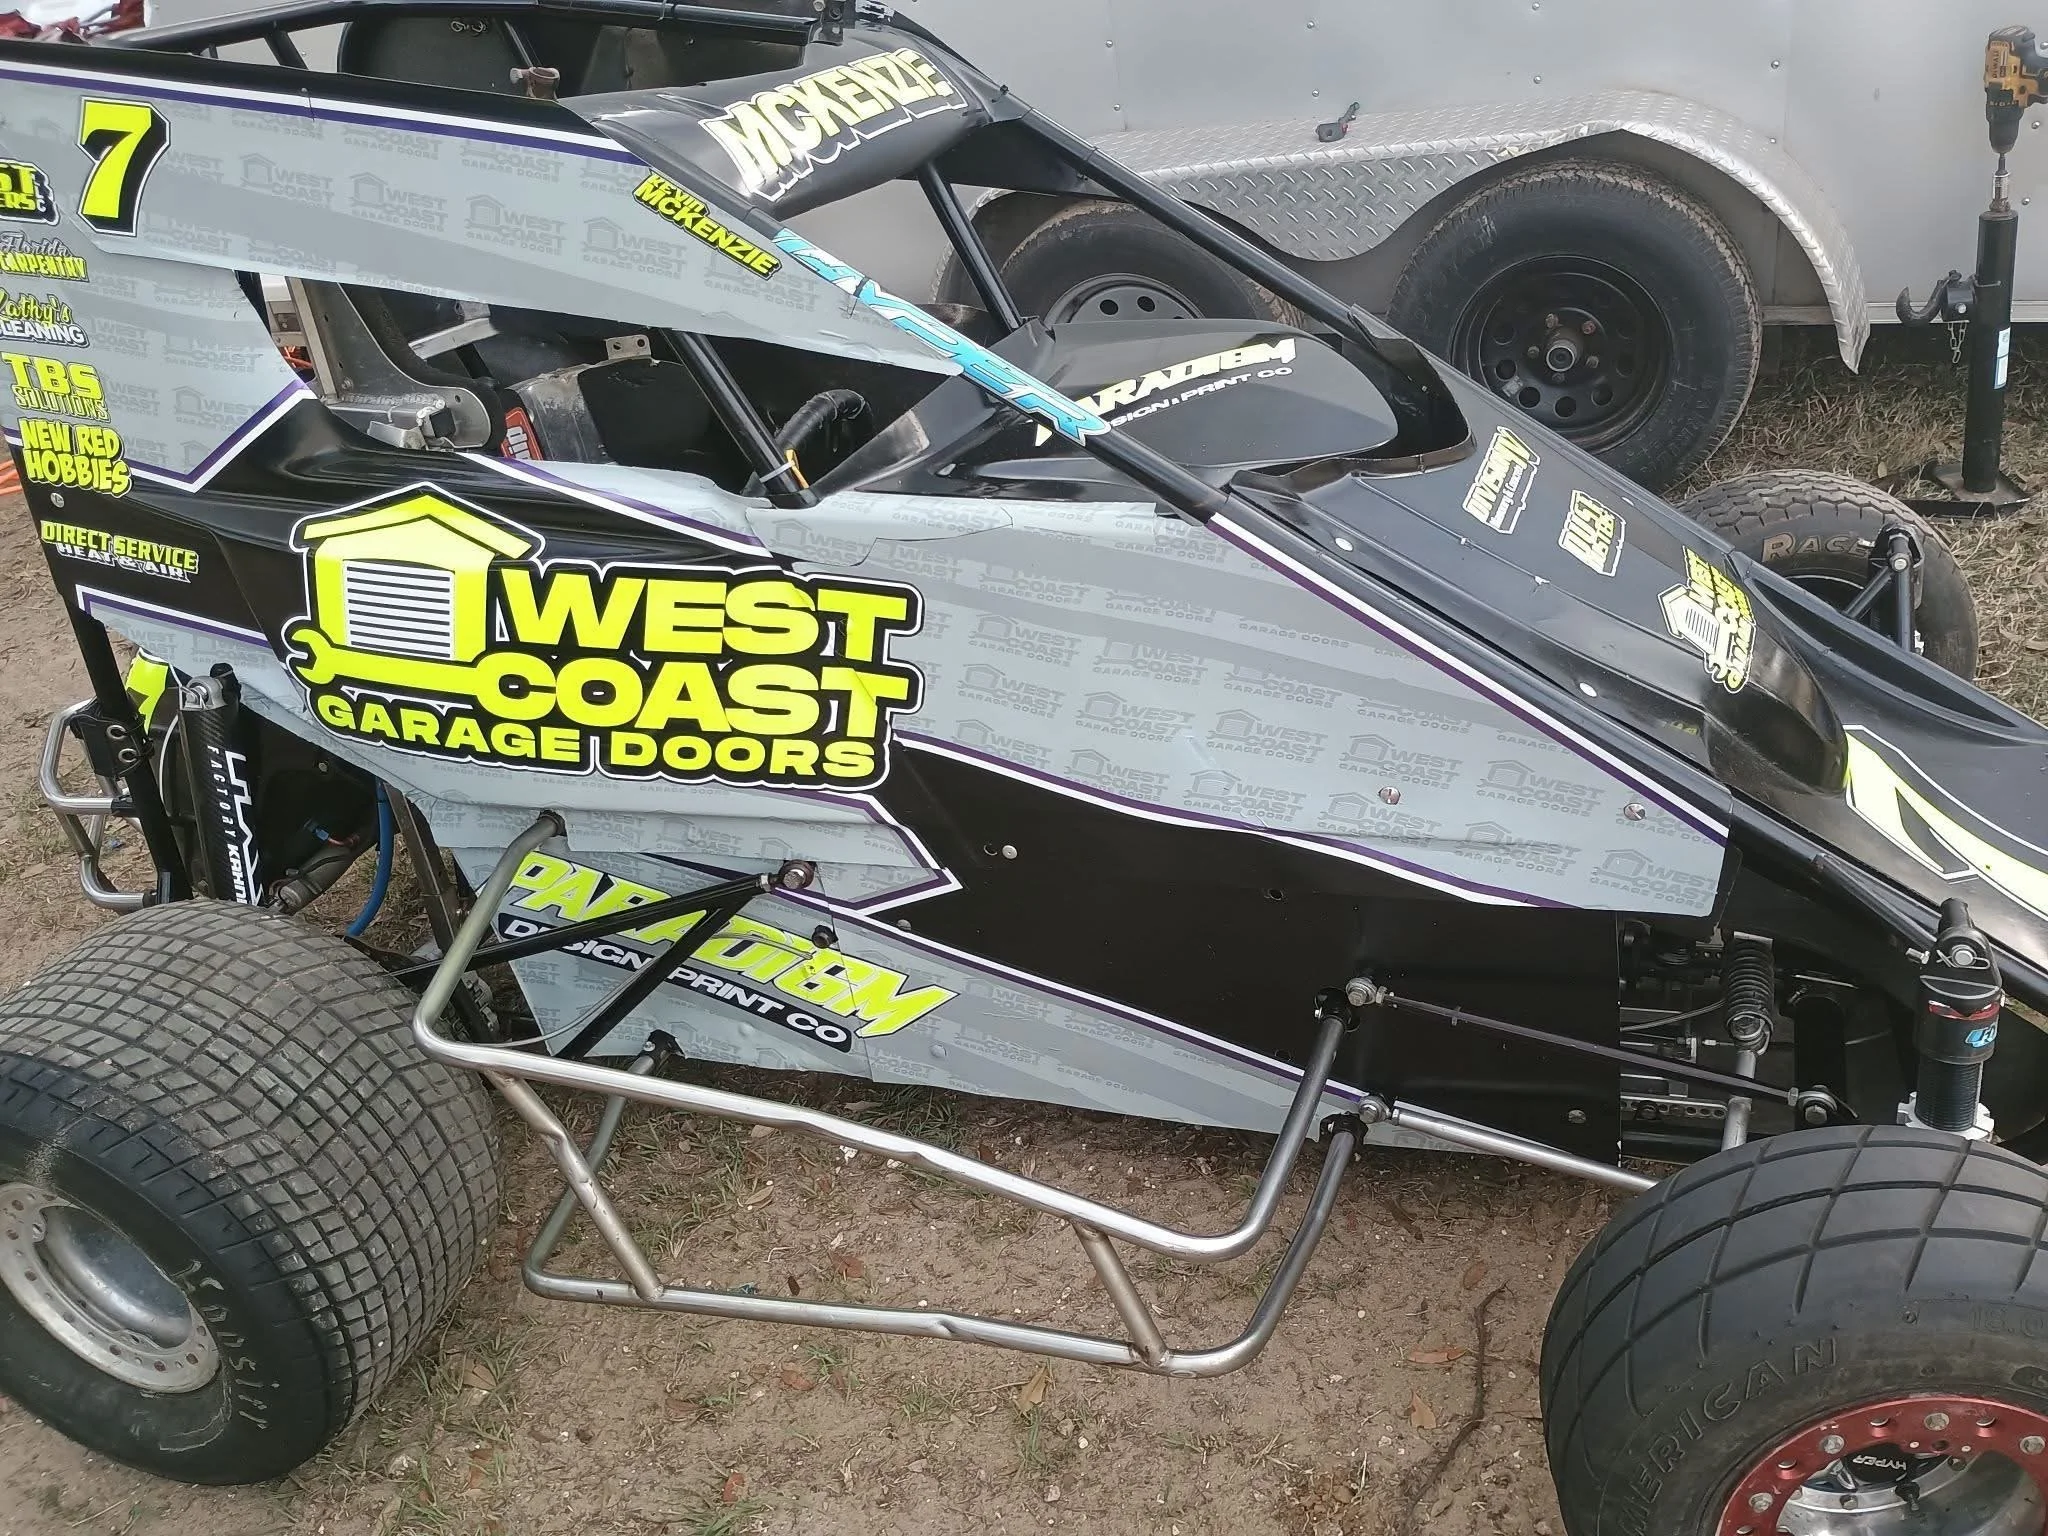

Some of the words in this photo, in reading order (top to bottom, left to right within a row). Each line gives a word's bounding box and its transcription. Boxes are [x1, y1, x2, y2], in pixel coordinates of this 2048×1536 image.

[702, 49, 957, 193] MCKENZIE
[80, 98, 160, 226] 7
[386, 187, 448, 210] WEST
[384, 202, 448, 224] COAST
[503, 210, 567, 233] WEST
[499, 223, 567, 248] COAST
[633, 184, 779, 277] MCKENZIE
[621, 233, 688, 254] WEST
[617, 249, 687, 273] COAST
[2, 352, 104, 400] TBS
[11, 386, 110, 421] SOLUTIONS
[1108, 399, 1170, 428] SIGN
[1181, 374, 1252, 402] PRINT
[1257, 367, 1293, 380] CO
[18, 418, 71, 453] NEW
[76, 425, 122, 460] RED
[23, 448, 131, 496] HOBBIES
[40, 520, 111, 552] DIRECT
[113, 535, 197, 570] SERVICE
[1762, 531, 1872, 563] RACE
[56, 542, 113, 565] HEAT
[142, 562, 188, 580] AIR
[500, 567, 909, 661] WEST
[1105, 602, 1160, 615] GARAGE
[1165, 609, 1213, 624] DOORS
[1016, 626, 1081, 648] WEST
[1239, 622, 1296, 639] GARAGE
[1301, 634, 1349, 649] DOORS
[1007, 639, 1080, 661] COAST
[1092, 665, 1149, 678] GARAGE
[1134, 658, 1208, 679] COAST
[474, 652, 909, 738] COAST
[992, 688, 1063, 713] COAST
[1001, 678, 1067, 701] WEST
[1224, 682, 1281, 698] GARAGE
[1286, 694, 1333, 709] DOORS
[1263, 680, 1343, 702] COAST
[1122, 703, 1195, 724] WEST
[1357, 708, 1415, 725] GARAGE
[1420, 720, 1469, 735] DOORS
[317, 695, 581, 763] GARAGE
[609, 731, 875, 779] DOORS
[1076, 720, 1127, 736] GARAGE
[1130, 731, 1174, 744] DOORS
[1111, 717, 1192, 737] COAST
[1257, 723, 1328, 746] WEST
[991, 734, 1052, 757] WEST
[1206, 741, 1261, 755] GARAGE
[1265, 749, 1315, 764] DOORS
[1247, 736, 1326, 757] COAST
[1381, 759, 1460, 783] COAST
[1392, 748, 1463, 770] WEST
[1107, 763, 1170, 784] WEST
[1338, 763, 1398, 778] GARAGE
[1401, 774, 1450, 790] DOORS
[1099, 775, 1168, 797] COAST
[1237, 783, 1307, 804] WEST
[1530, 775, 1606, 799] WEST
[1226, 796, 1303, 817] COAST
[1476, 789, 1535, 806] GARAGE
[1540, 801, 1591, 818] DOORS
[1519, 785, 1600, 812] COAST
[206, 744, 237, 839] FACTORY
[227, 842, 248, 904] KAHN
[1369, 805, 1441, 833] WEST
[1515, 860, 1566, 877] DOORS
[1590, 877, 1650, 897] GARAGE
[1654, 891, 1705, 910] DOORS
[1633, 877, 1717, 902] COAST
[504, 919, 653, 972] DSIGN
[667, 966, 785, 1015] PRINT
[786, 1011, 848, 1045] CO
[1853, 1453, 1908, 1472] HYPER
